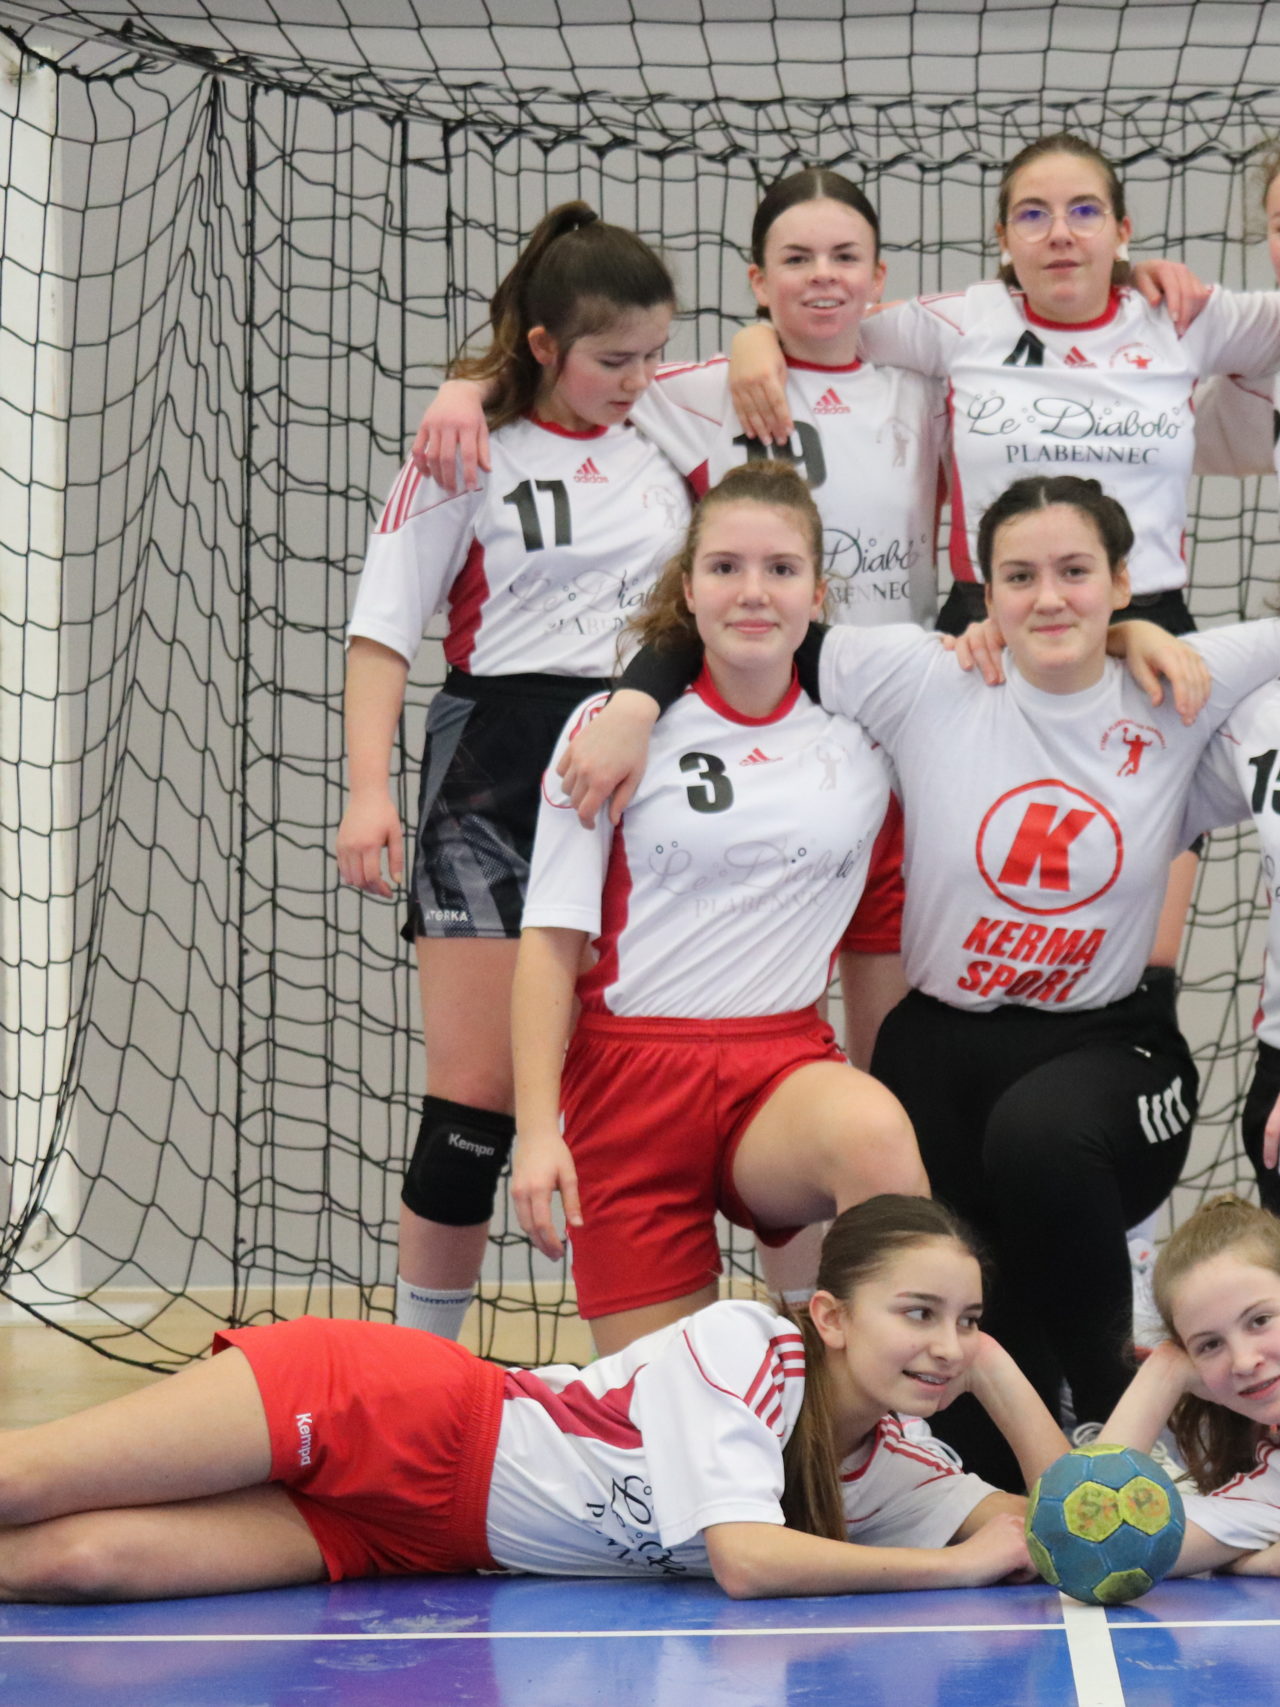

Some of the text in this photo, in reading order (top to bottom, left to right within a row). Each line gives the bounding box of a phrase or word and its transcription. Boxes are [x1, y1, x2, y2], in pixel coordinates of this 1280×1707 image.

[813, 405, 851, 415] adidas
[967, 395, 1182, 440] Le Diabolo
[1005, 444, 1161, 466] PLABENNEC
[573, 474, 609, 484] adidas
[502, 478, 572, 553] 17
[678, 751, 735, 815] 3
[997, 802, 1098, 892] K
[961, 916, 1107, 967] KERMA
[956, 960, 1092, 1004] SPORT
[448, 1132, 496, 1158] Kempa
[295, 1412, 314, 1467] Kempa
